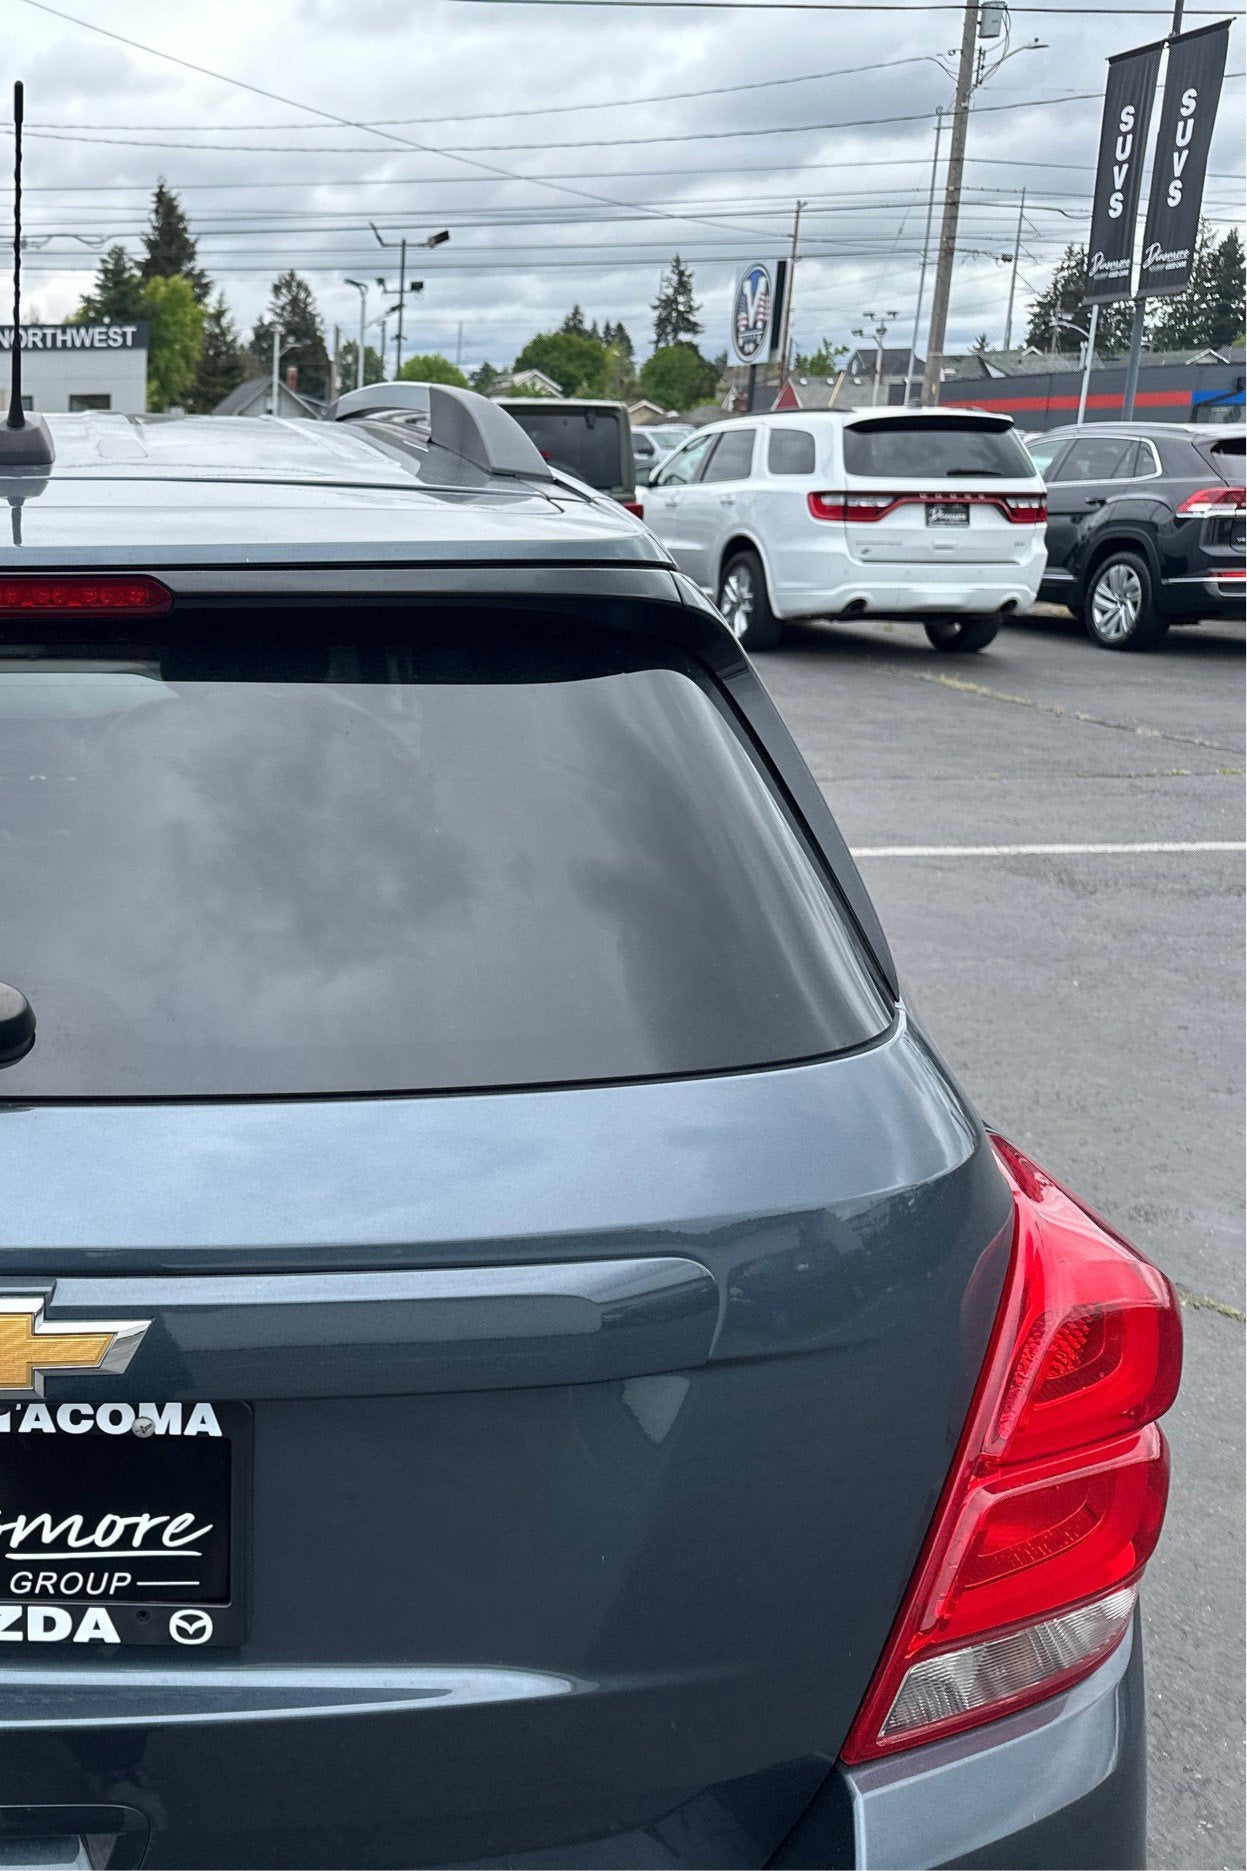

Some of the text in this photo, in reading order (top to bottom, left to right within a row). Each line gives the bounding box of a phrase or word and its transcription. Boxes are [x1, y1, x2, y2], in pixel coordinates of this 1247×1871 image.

[1108, 105, 1135, 218] SUVS
[1167, 88, 1198, 208] SUVS
[10, 1571, 132, 1595] GROUP
